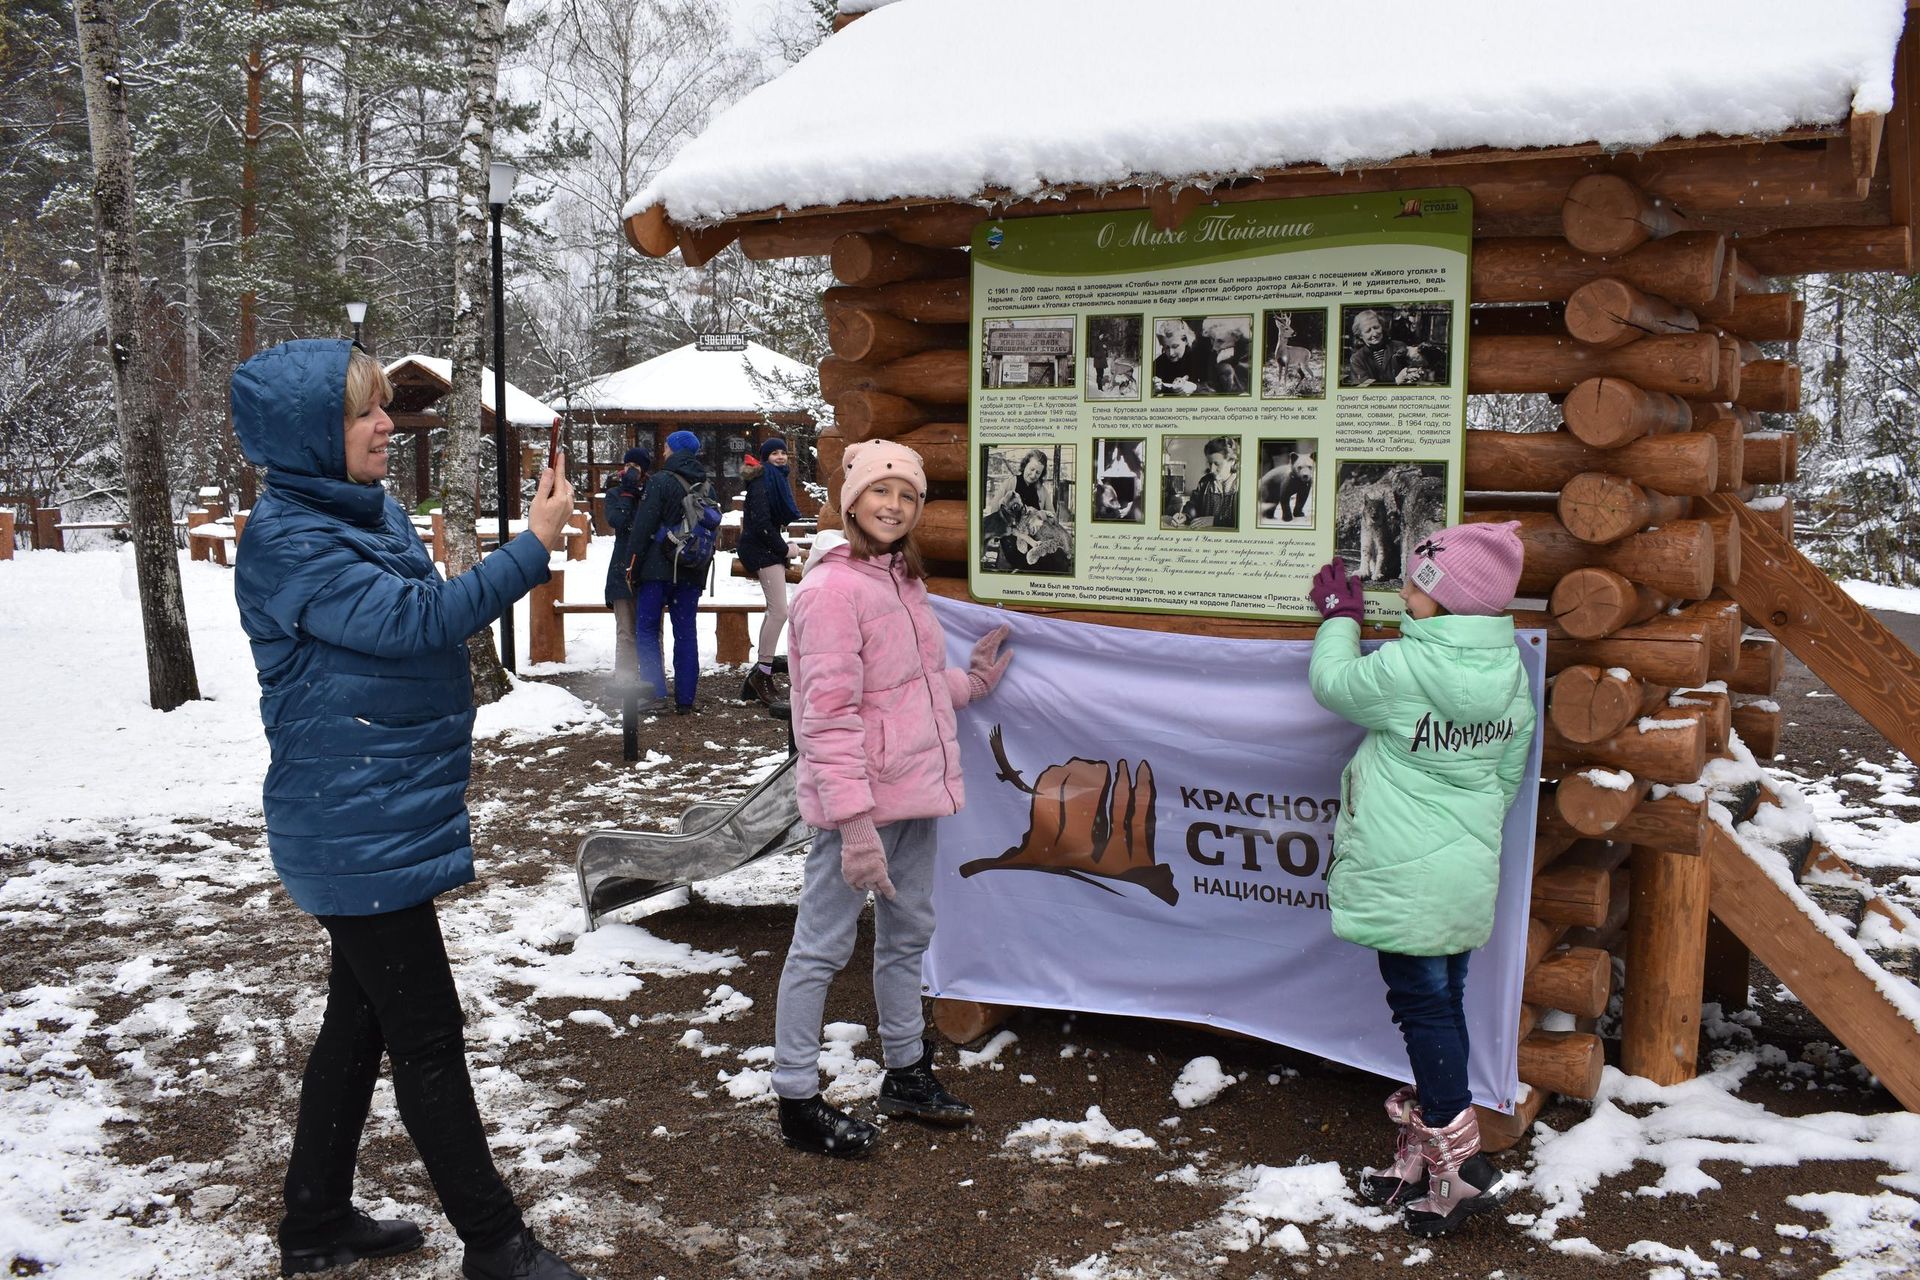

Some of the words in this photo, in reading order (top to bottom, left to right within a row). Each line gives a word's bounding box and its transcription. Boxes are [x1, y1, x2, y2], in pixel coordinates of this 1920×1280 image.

[1097, 222, 1116, 249] О
[1118, 220, 1187, 248] Михе
[1194, 213, 1315, 243] Тайгише
[1021, 285, 1035, 293] 2000
[1083, 283, 1122, 291] заповедник
[1125, 280, 1159, 288] «Столбы»
[1184, 279, 1197, 287] для
[1236, 275, 1281, 285] неразрывно
[1320, 271, 1367, 280] посещением
[1370, 269, 1404, 277] «Живого
[1407, 268, 1437, 277] уголка»
[1065, 291, 1093, 301] который
[1097, 290, 1138, 300] красноярцы
[1181, 287, 1218, 296] «Приютом
[1222, 285, 1252, 294] доброго
[1256, 284, 1287, 292] доктора
[1291, 282, 1337, 290] Ай-Болита».
[1366, 278, 1421, 288] удивительно,
[1426, 277, 1446, 285] ведь
[988, 303, 1040, 311] «постояльцами»
[1042, 301, 1070, 309] «Уголка»
[1117, 298, 1151, 306] попавшие
[1160, 296, 1176, 305] беду
[1178, 296, 1198, 304] звери
[1207, 295, 1231, 303] птицы:
[1234, 292, 1304, 302] сироты-детёныши,
[1306, 290, 1342, 299] подранки
[1354, 289, 1384, 297] жертвы
[700, 334, 745, 345] СУВЕНИРЫ
[1336, 394, 1359, 402] Приют
[1362, 394, 1388, 402] быстро
[1114, 406, 1147, 415] Крутовская
[1261, 406, 1294, 414] переломы
[1336, 412, 1363, 420] орлами,
[1389, 437, 1416, 445] Тайгиш,
[1419, 437, 1450, 445] будущая
[1029, 581, 1046, 589] Миха
[1096, 585, 1131, 594] любимцем
[1133, 588, 1165, 596] туристов,
[1218, 592, 1262, 600] талисманом
[1264, 593, 1302, 602] «Приюта».
[1031, 589, 1053, 597] Живом
[1055, 591, 1077, 600] уголке,
[1153, 597, 1188, 606] площадку
[1200, 599, 1229, 607] кордоне
[1231, 600, 1265, 608] Лалетино
[1277, 602, 1304, 610] Лесной
[1180, 786, 1341, 823] КРАСНОЯ
